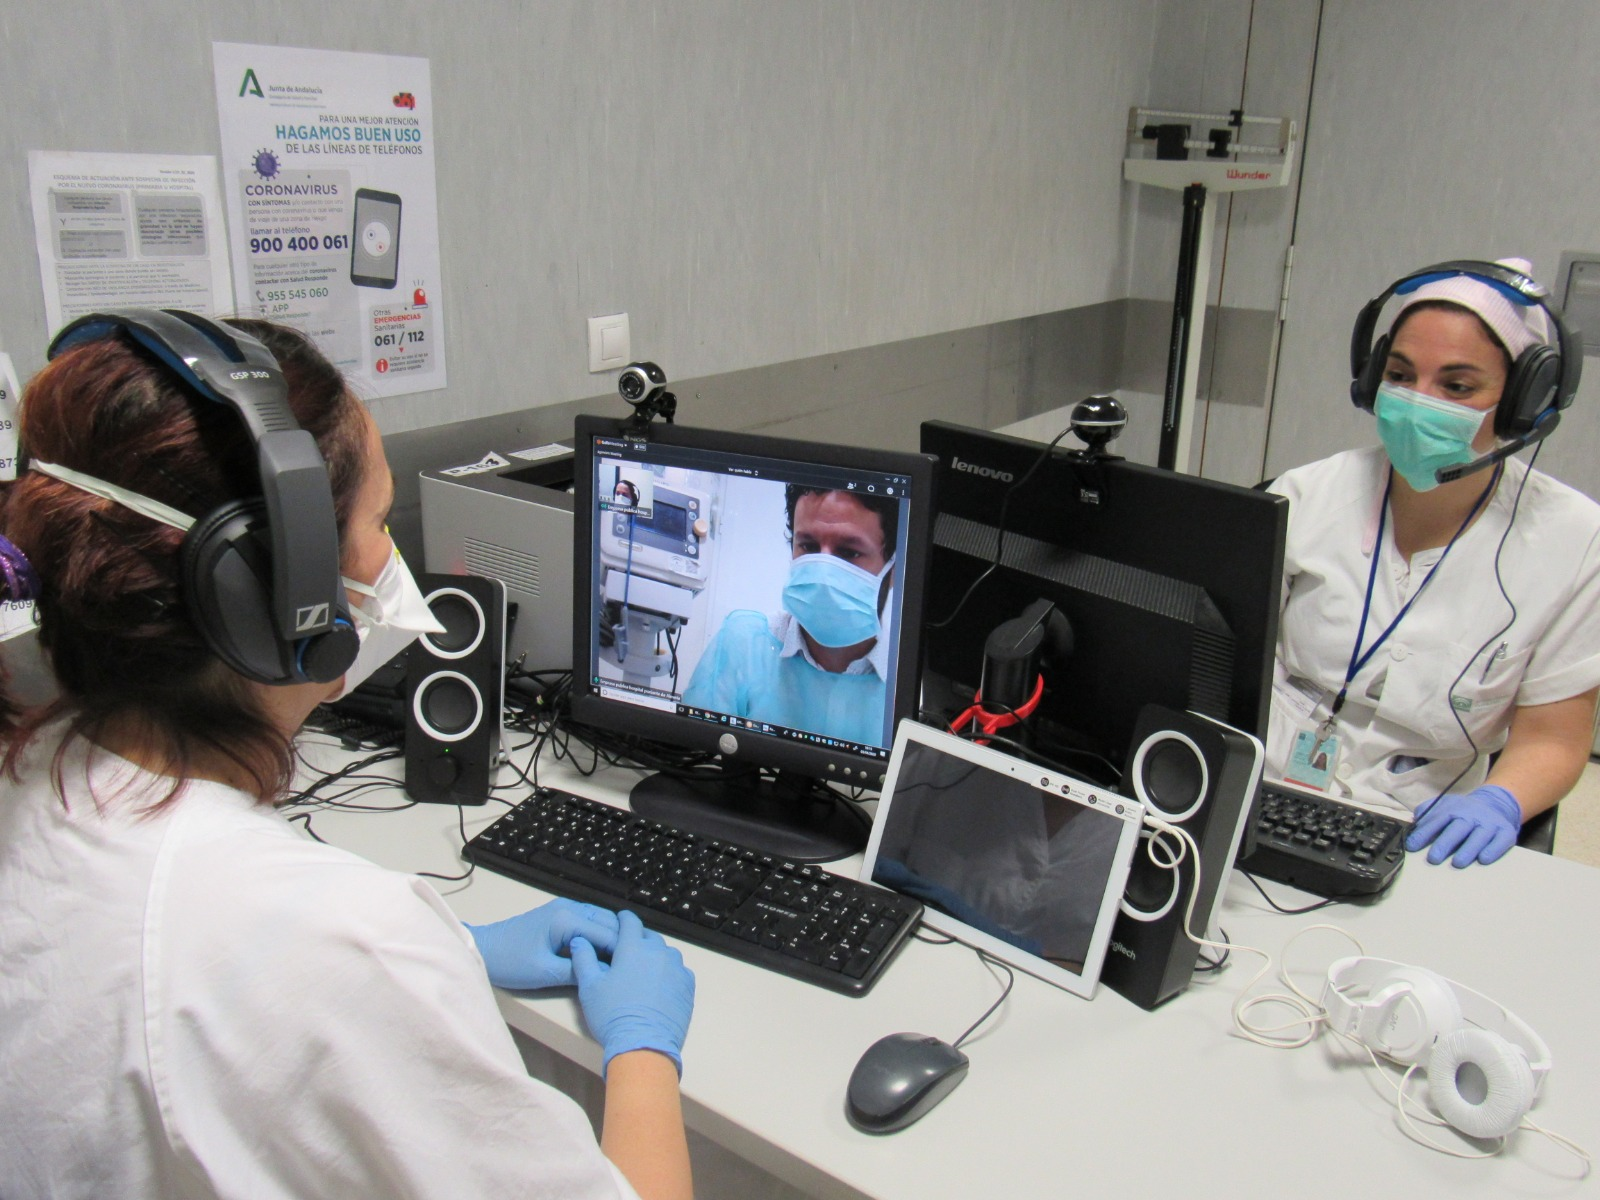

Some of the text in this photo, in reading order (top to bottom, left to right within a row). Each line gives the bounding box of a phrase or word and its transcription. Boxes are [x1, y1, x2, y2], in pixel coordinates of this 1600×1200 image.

[269, 85, 286, 93] Junta
[319, 115, 419, 126] PARA UNA MEJOR ATENCIÓN
[275, 125, 421, 142] HAGAMOS BUEN USO
[286, 142, 423, 155] DE LAS LÍNEAS DE TELÉFONOS
[1227, 169, 1271, 180] Wunder
[245, 184, 339, 197] CORONAVIRUS
[261, 199, 291, 207] SÍNTOMAS
[250, 225, 311, 236] llamar al teléfono
[250, 233, 349, 254] 900 400 061
[267, 287, 329, 301] 955 545 060
[272, 303, 289, 313] APP
[373, 309, 391, 317] Otras
[373, 313, 422, 324] EMERGENCIAS
[374, 322, 406, 331] Sanitarias
[374, 334, 395, 347] 061
[407, 330, 425, 343] 112
[230, 371, 270, 380] GSP 300
[951, 456, 1014, 484] lenovo
